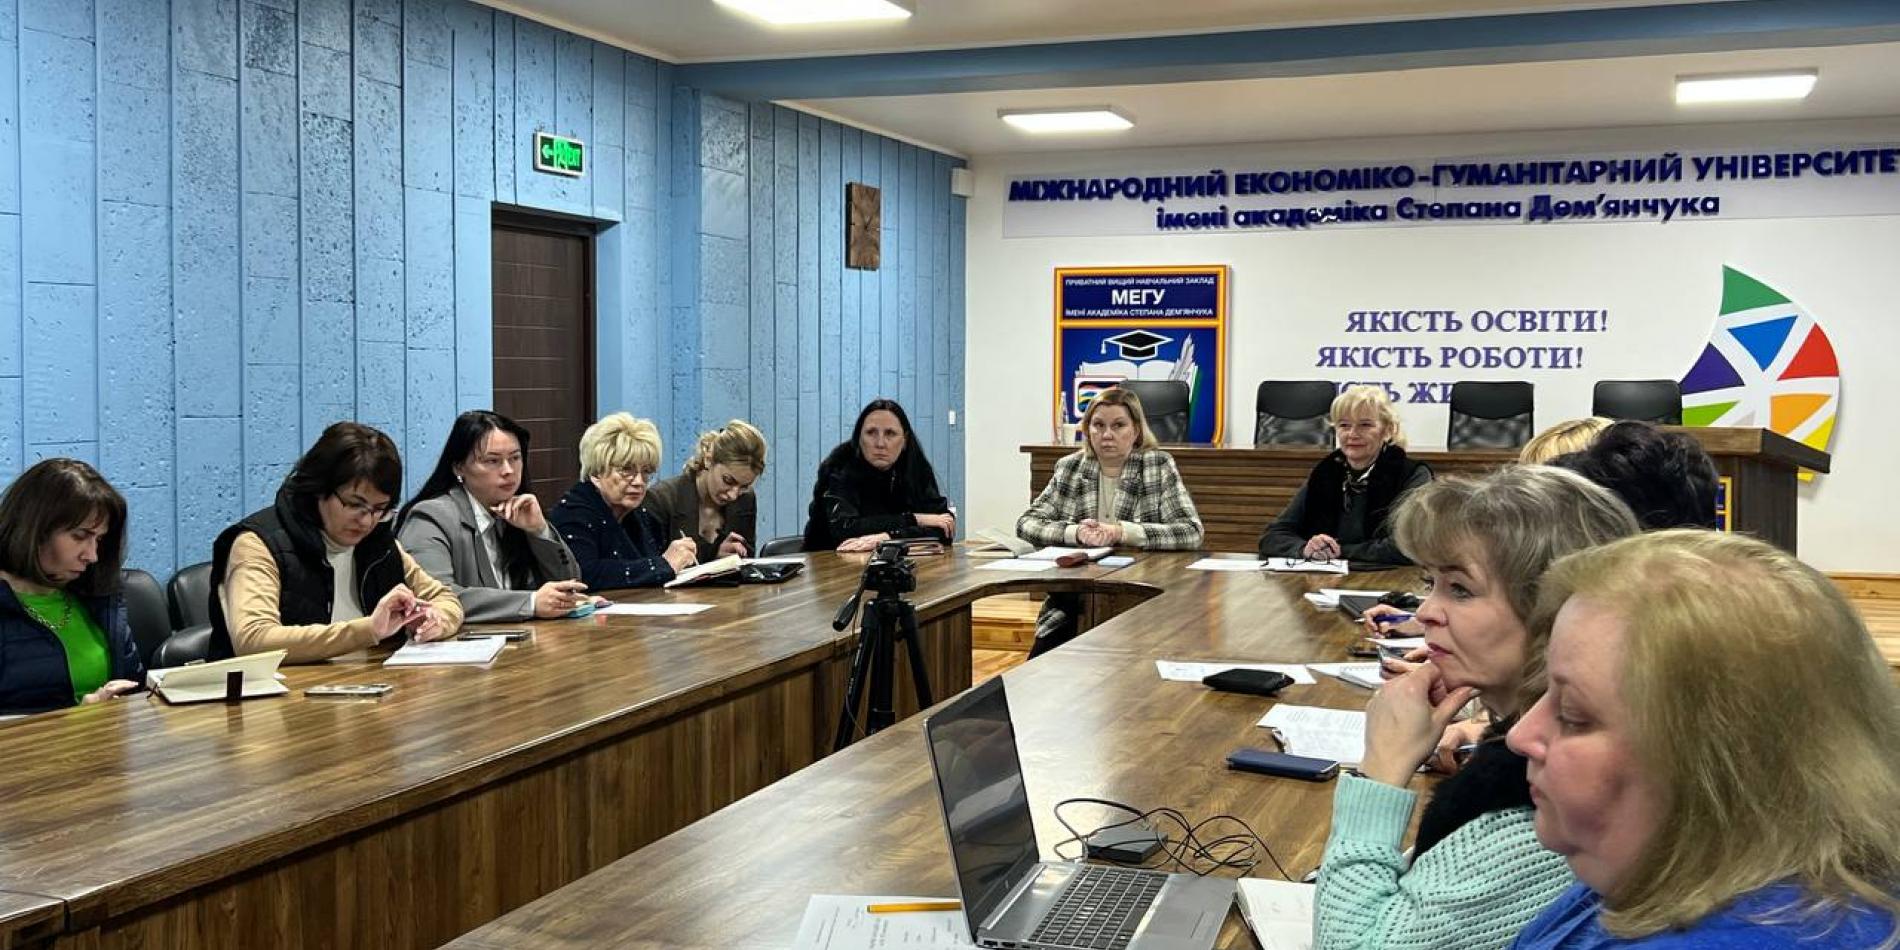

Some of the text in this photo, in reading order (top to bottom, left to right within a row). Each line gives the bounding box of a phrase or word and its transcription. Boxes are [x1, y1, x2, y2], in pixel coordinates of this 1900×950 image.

[1008, 170, 1227, 202] МІЖНАРОДНИЙ
[1694, 147, 1900, 183] УНІВЕРСИТЕ
[1156, 193, 1721, 230] імені академіка Степана Дем'янчука
[1111, 288, 1166, 306] МЕГУ
[1345, 309, 1608, 333] ЯКІСТЬ ОСВІТИ!
[1315, 346, 1584, 369] ЯКІСТЬ РОБОТИ!
